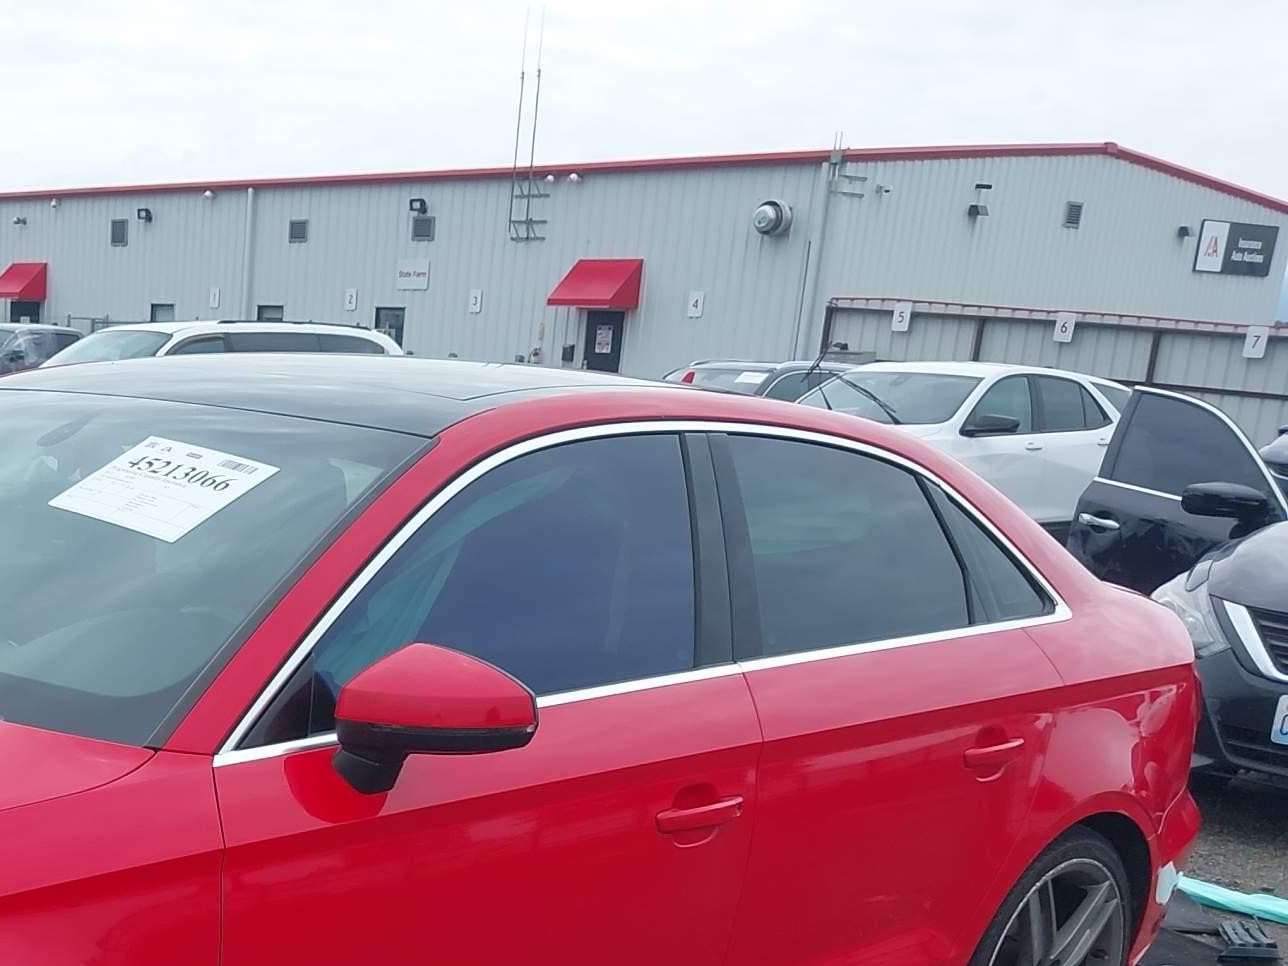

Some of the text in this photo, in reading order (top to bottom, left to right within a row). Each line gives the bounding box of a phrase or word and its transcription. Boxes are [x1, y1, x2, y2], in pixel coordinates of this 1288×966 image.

[897, 311, 905, 323] 5
[1060, 321, 1068, 333] 6
[1252, 335, 1261, 349] 7
[128, 456, 236, 491] 45213066
